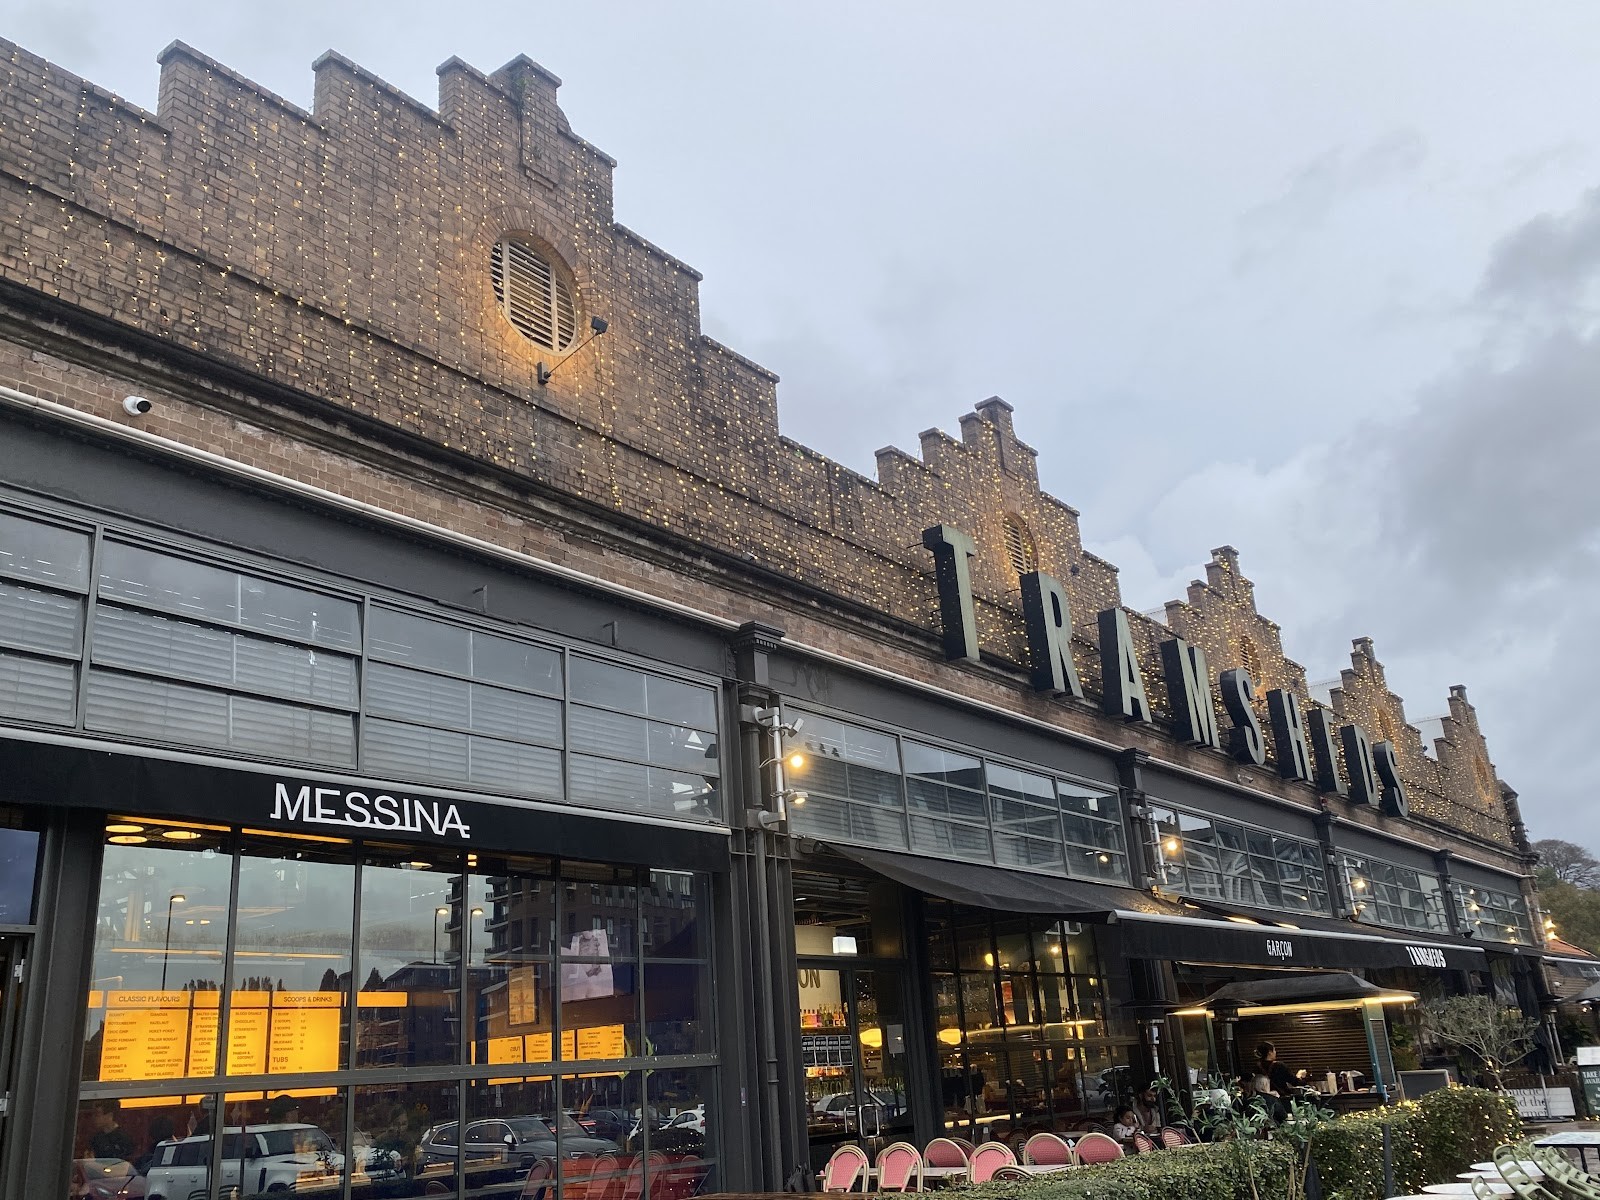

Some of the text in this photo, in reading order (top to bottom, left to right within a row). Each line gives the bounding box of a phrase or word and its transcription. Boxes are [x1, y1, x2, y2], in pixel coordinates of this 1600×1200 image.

[922, 524, 1409, 818] TRAMSHEDS
[270, 783, 471, 839] MESSINA
[1266, 939, 1293, 960] GARÇON
[118, 995, 181, 1003] CLASSIC FLAVOURS
